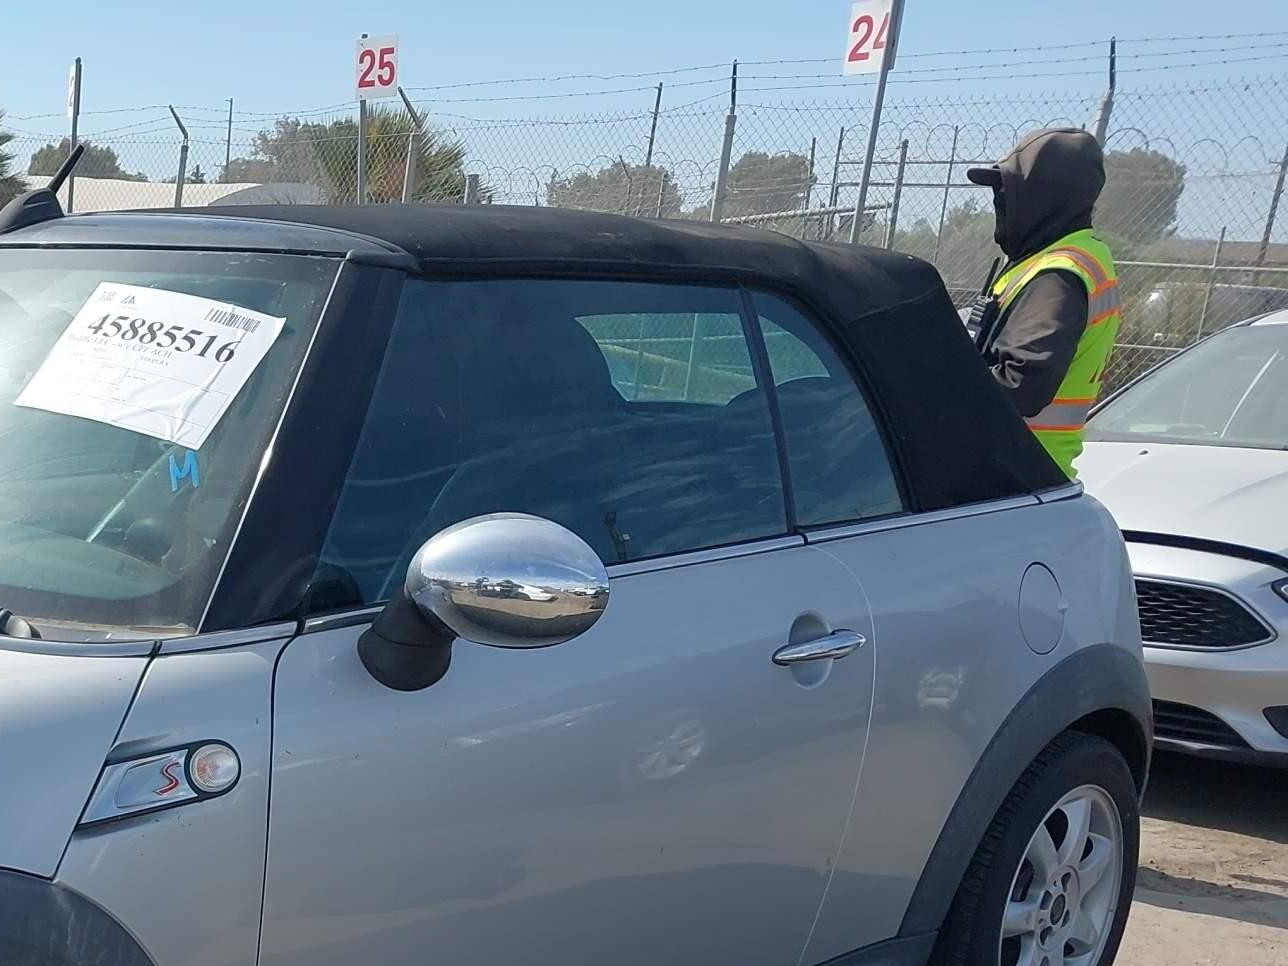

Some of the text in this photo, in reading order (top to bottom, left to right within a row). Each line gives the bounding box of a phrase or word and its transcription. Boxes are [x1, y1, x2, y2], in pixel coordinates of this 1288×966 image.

[358, 47, 395, 88] 25
[87, 313, 243, 363] 45885516
[152, 761, 182, 796] S
